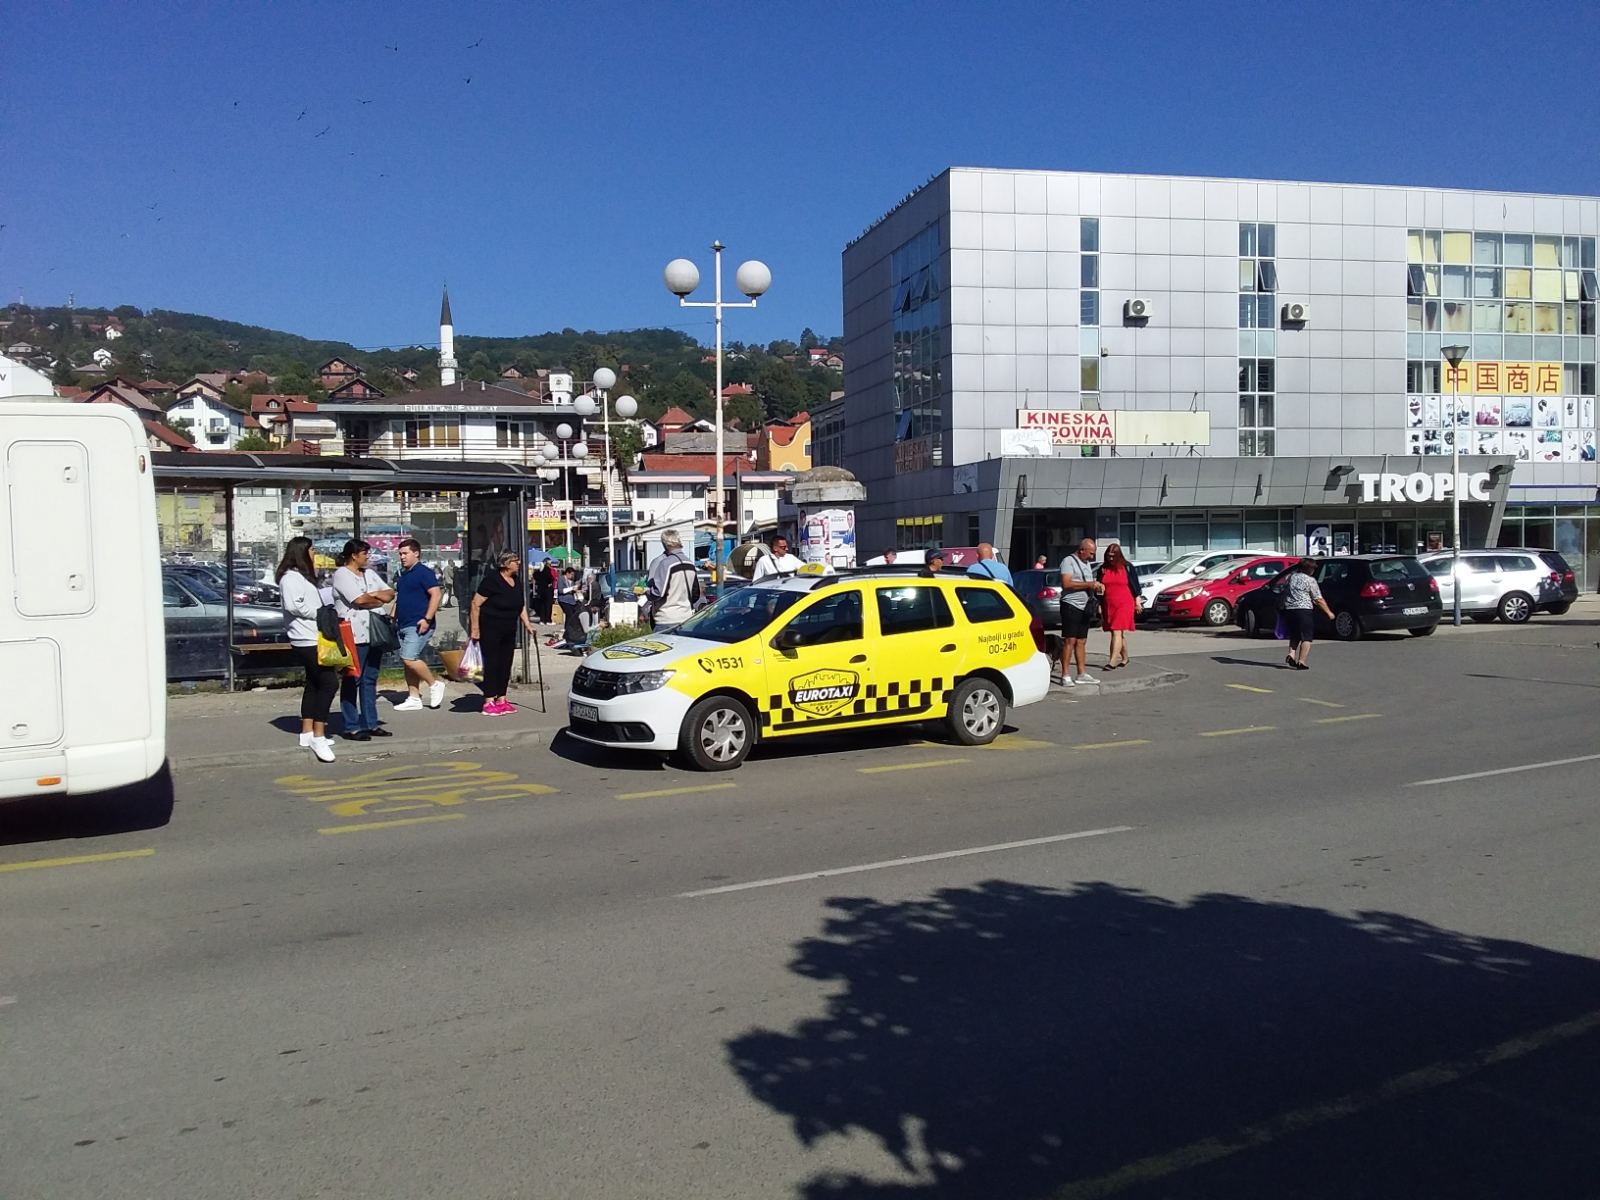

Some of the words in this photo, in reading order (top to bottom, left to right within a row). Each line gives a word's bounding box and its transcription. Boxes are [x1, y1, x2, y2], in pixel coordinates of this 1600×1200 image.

[1446, 363, 1561, 393] 中国商店
[1027, 412, 1109, 425] KINESKA
[1020, 426, 1113, 438] GOVINA
[1359, 472, 1490, 502] TROPIC
[978, 632, 1001, 643] Najbolji
[1008, 630, 1024, 641] gradu
[988, 642, 1017, 654] 00-24h
[716, 656, 744, 670] 1531
[795, 685, 854, 702] EUROTAXI
